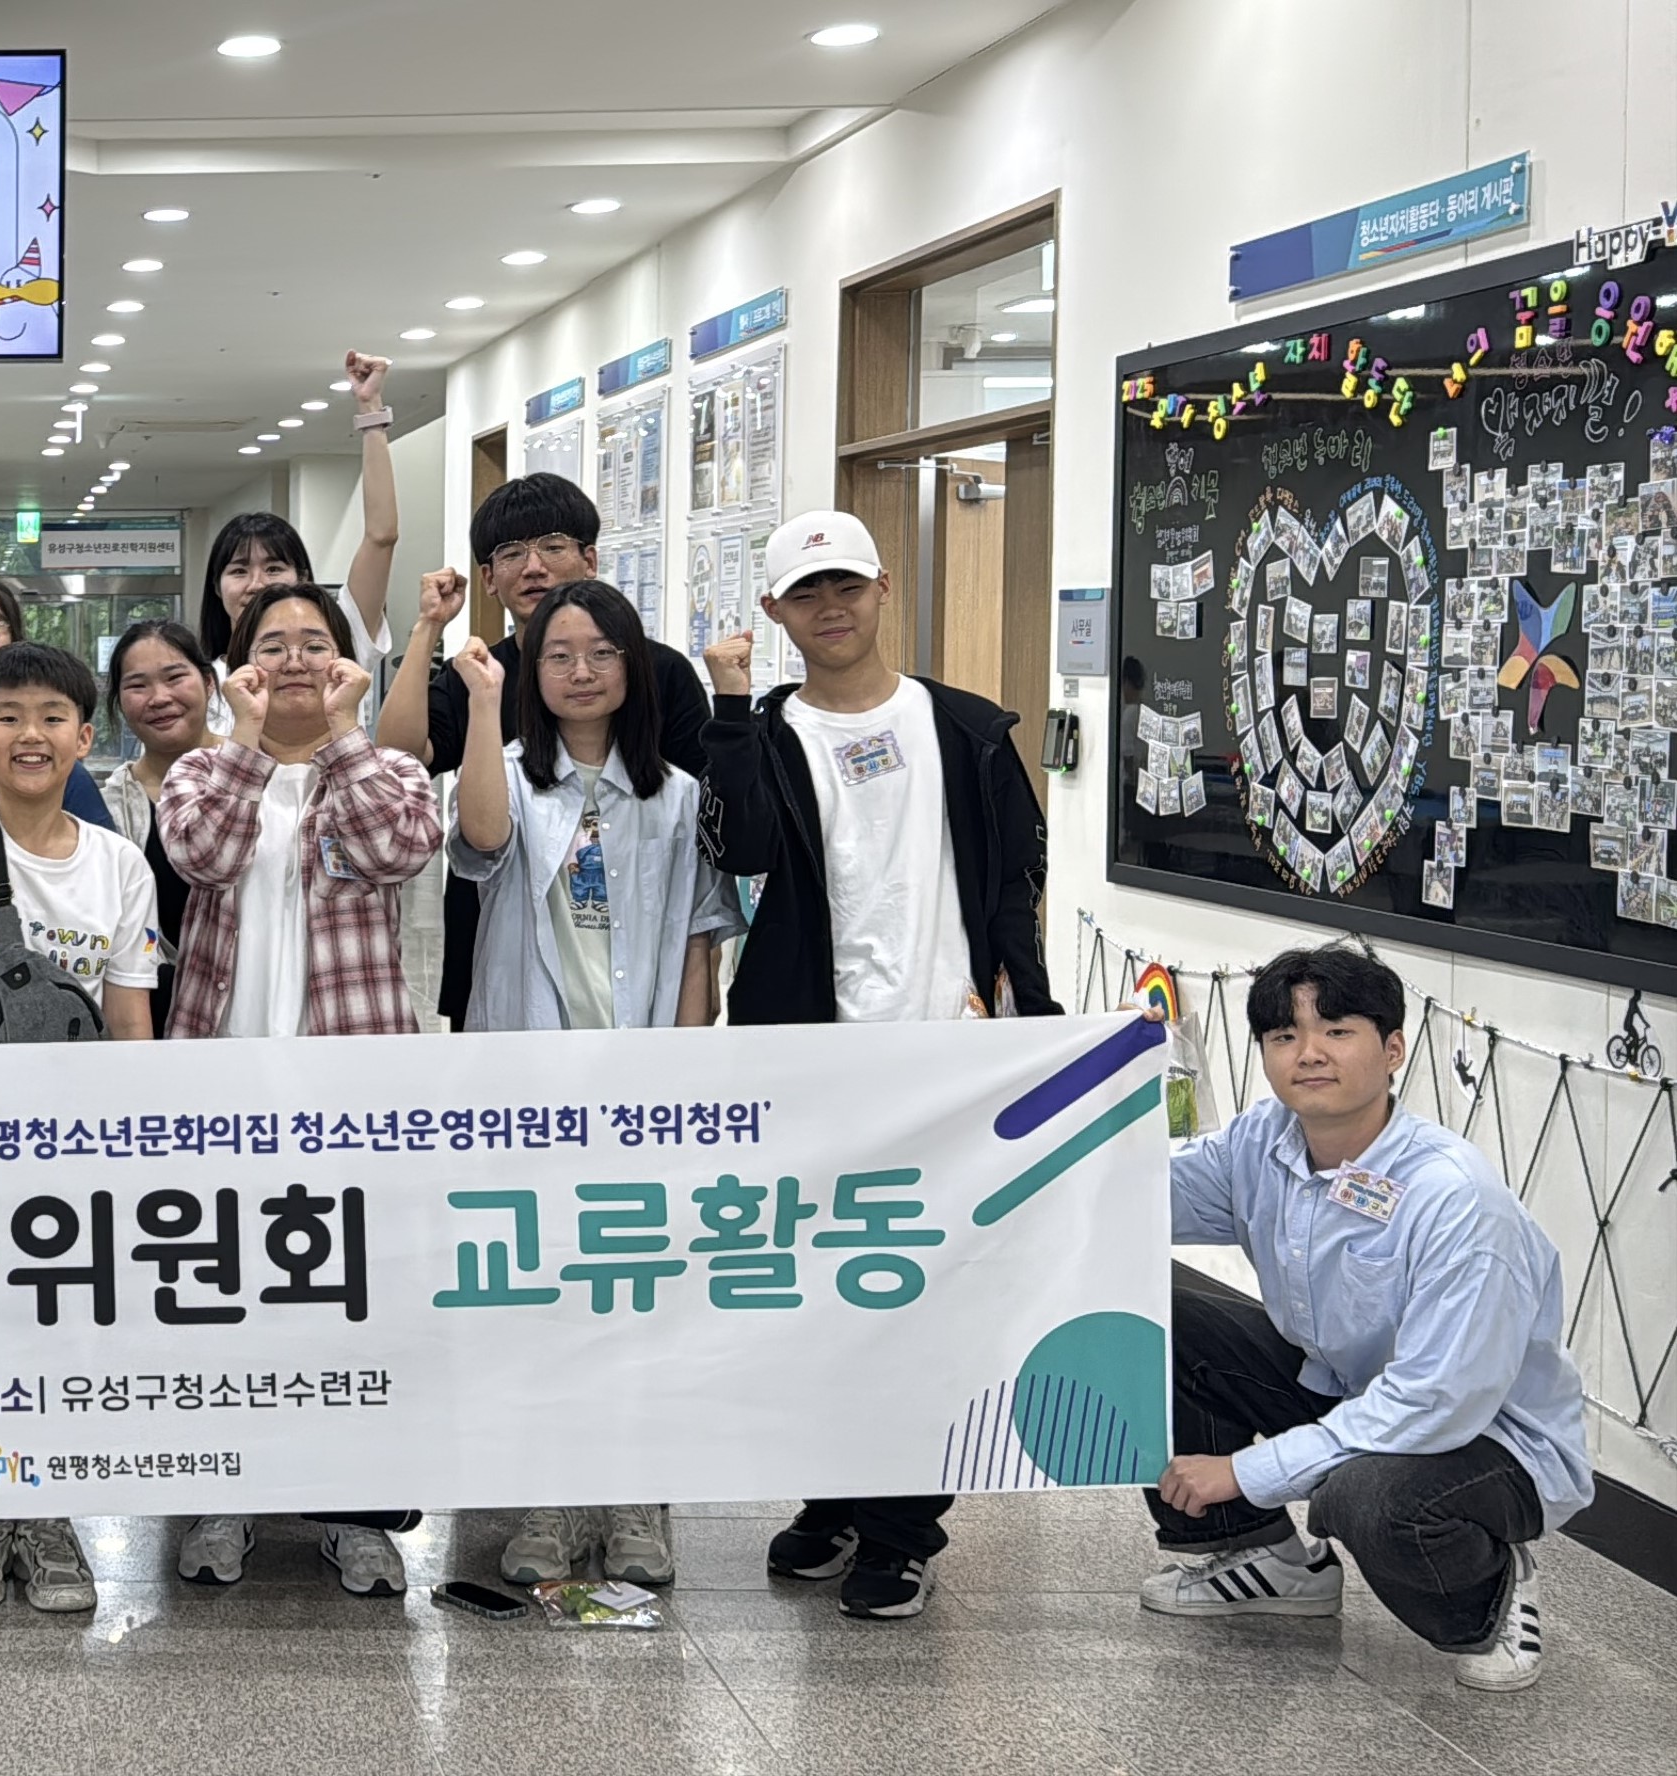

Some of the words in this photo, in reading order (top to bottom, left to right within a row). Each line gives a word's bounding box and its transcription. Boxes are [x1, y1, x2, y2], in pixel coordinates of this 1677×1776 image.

[1481, 175, 1515, 211] 게시판
[1071, 618, 1092, 637] 사무실
[291, 1106, 588, 1154] 청소년운영위원회
[600, 1101, 771, 1147] '청위청위'
[432, 1168, 946, 1314] 교류활동
[62, 1370, 392, 1412] 유성구청소년수련관
[47, 1452, 241, 1480] 원평청소년문화의집
